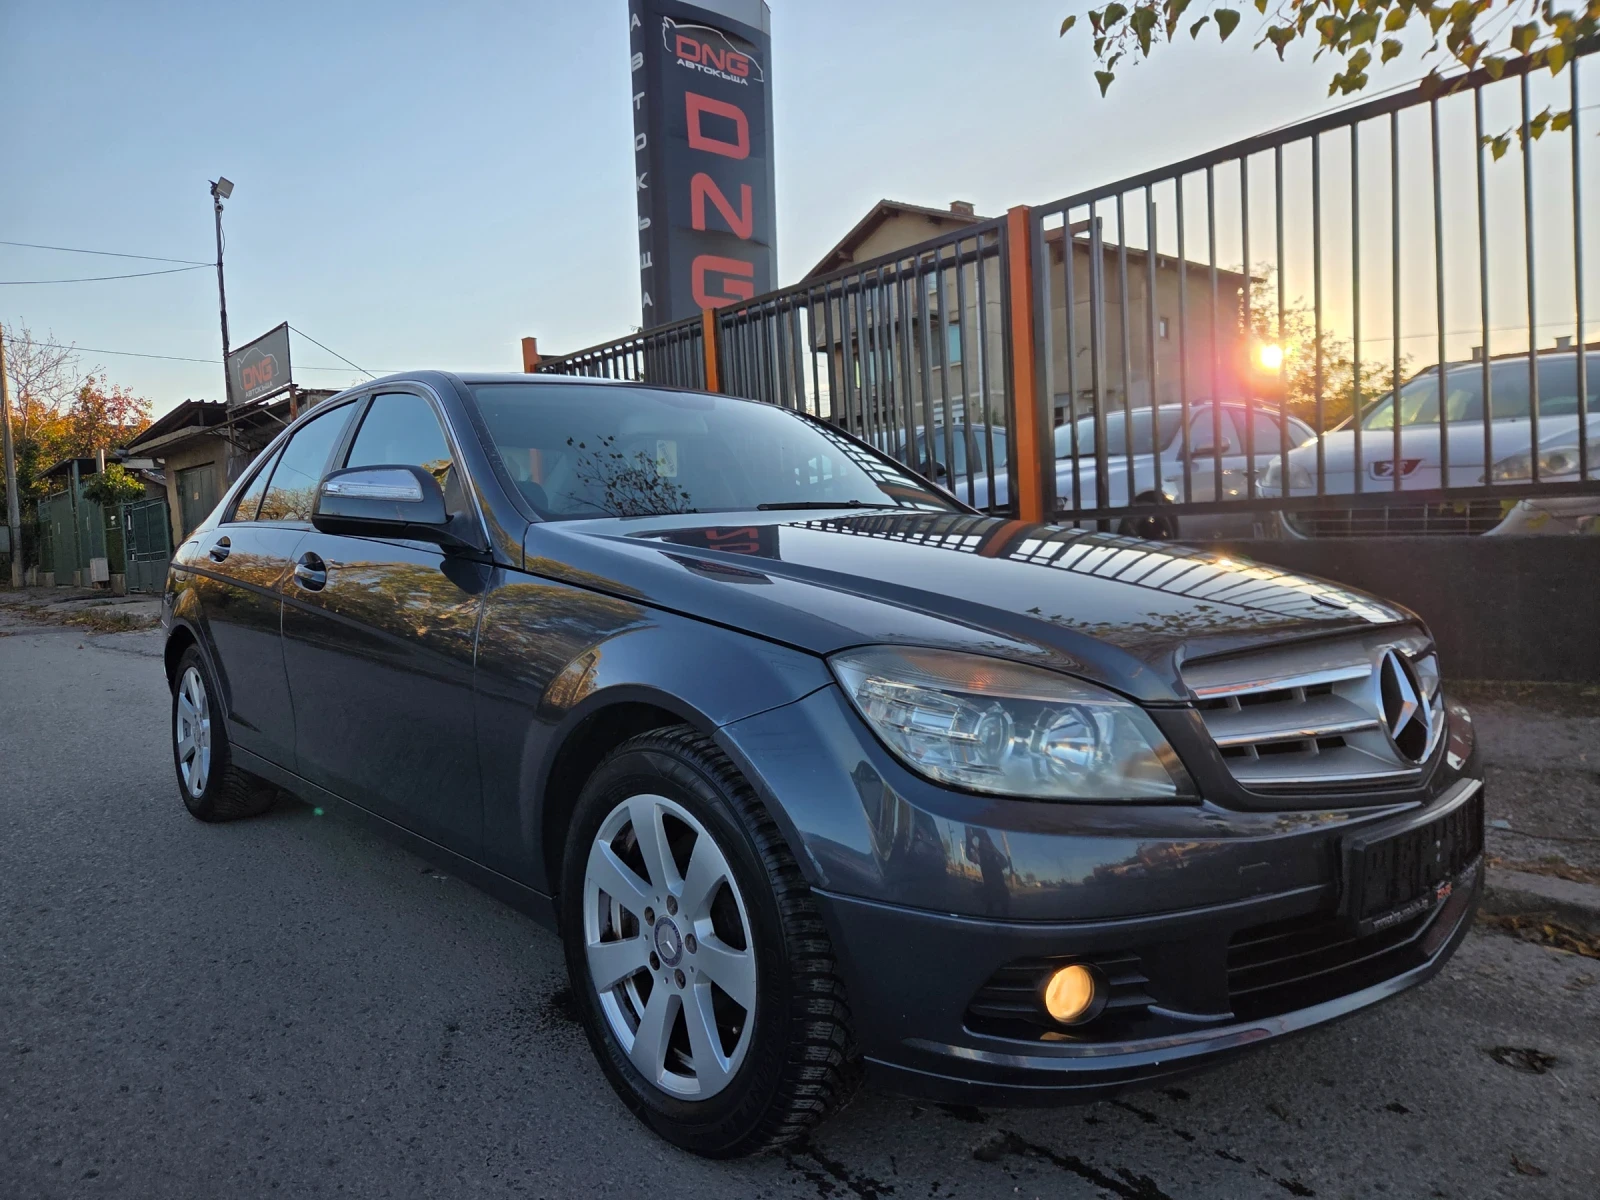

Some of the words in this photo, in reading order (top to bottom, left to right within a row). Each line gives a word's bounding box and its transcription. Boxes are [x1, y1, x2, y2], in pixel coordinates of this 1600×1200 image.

[676, 34, 749, 77] DNG
[685, 91, 754, 313] DNG
[242, 356, 273, 391] DNG
